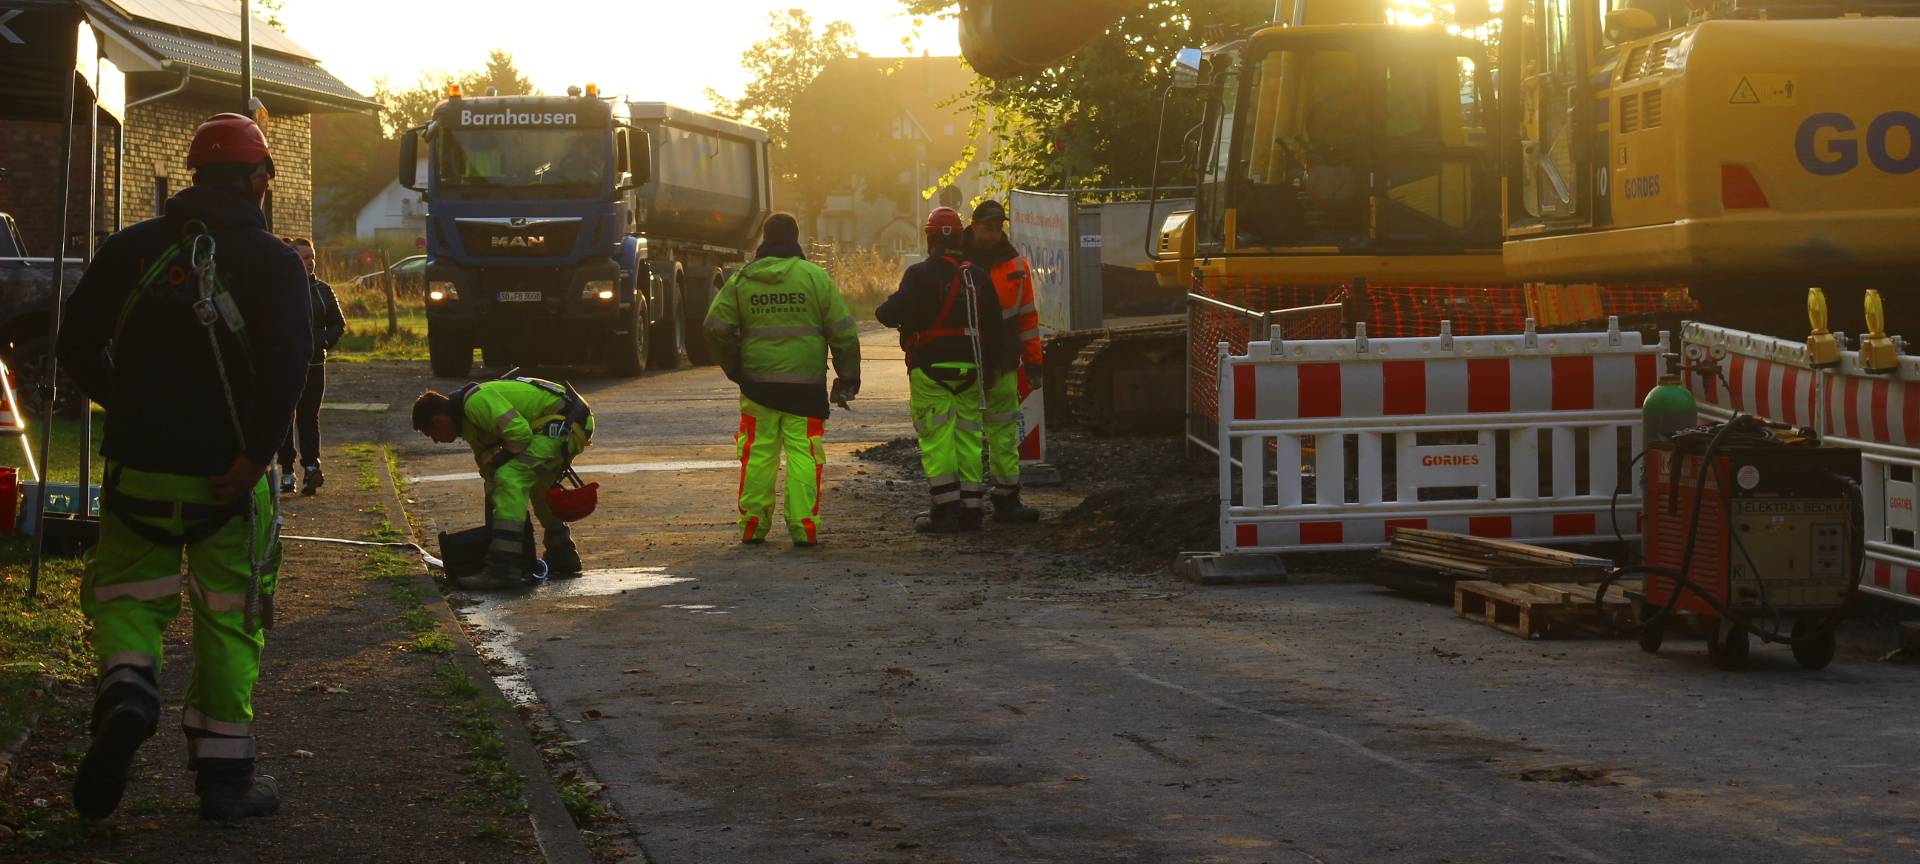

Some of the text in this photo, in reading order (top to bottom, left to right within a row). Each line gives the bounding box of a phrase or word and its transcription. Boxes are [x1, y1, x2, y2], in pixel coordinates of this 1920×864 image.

[460, 108, 577, 126] Barnhausen
[1794, 111, 1920, 176] GO
[1624, 175, 1661, 200] GORDES
[491, 235, 544, 248] MAN
[750, 292, 807, 306] GORDES
[1422, 454, 1479, 467] GORDES
